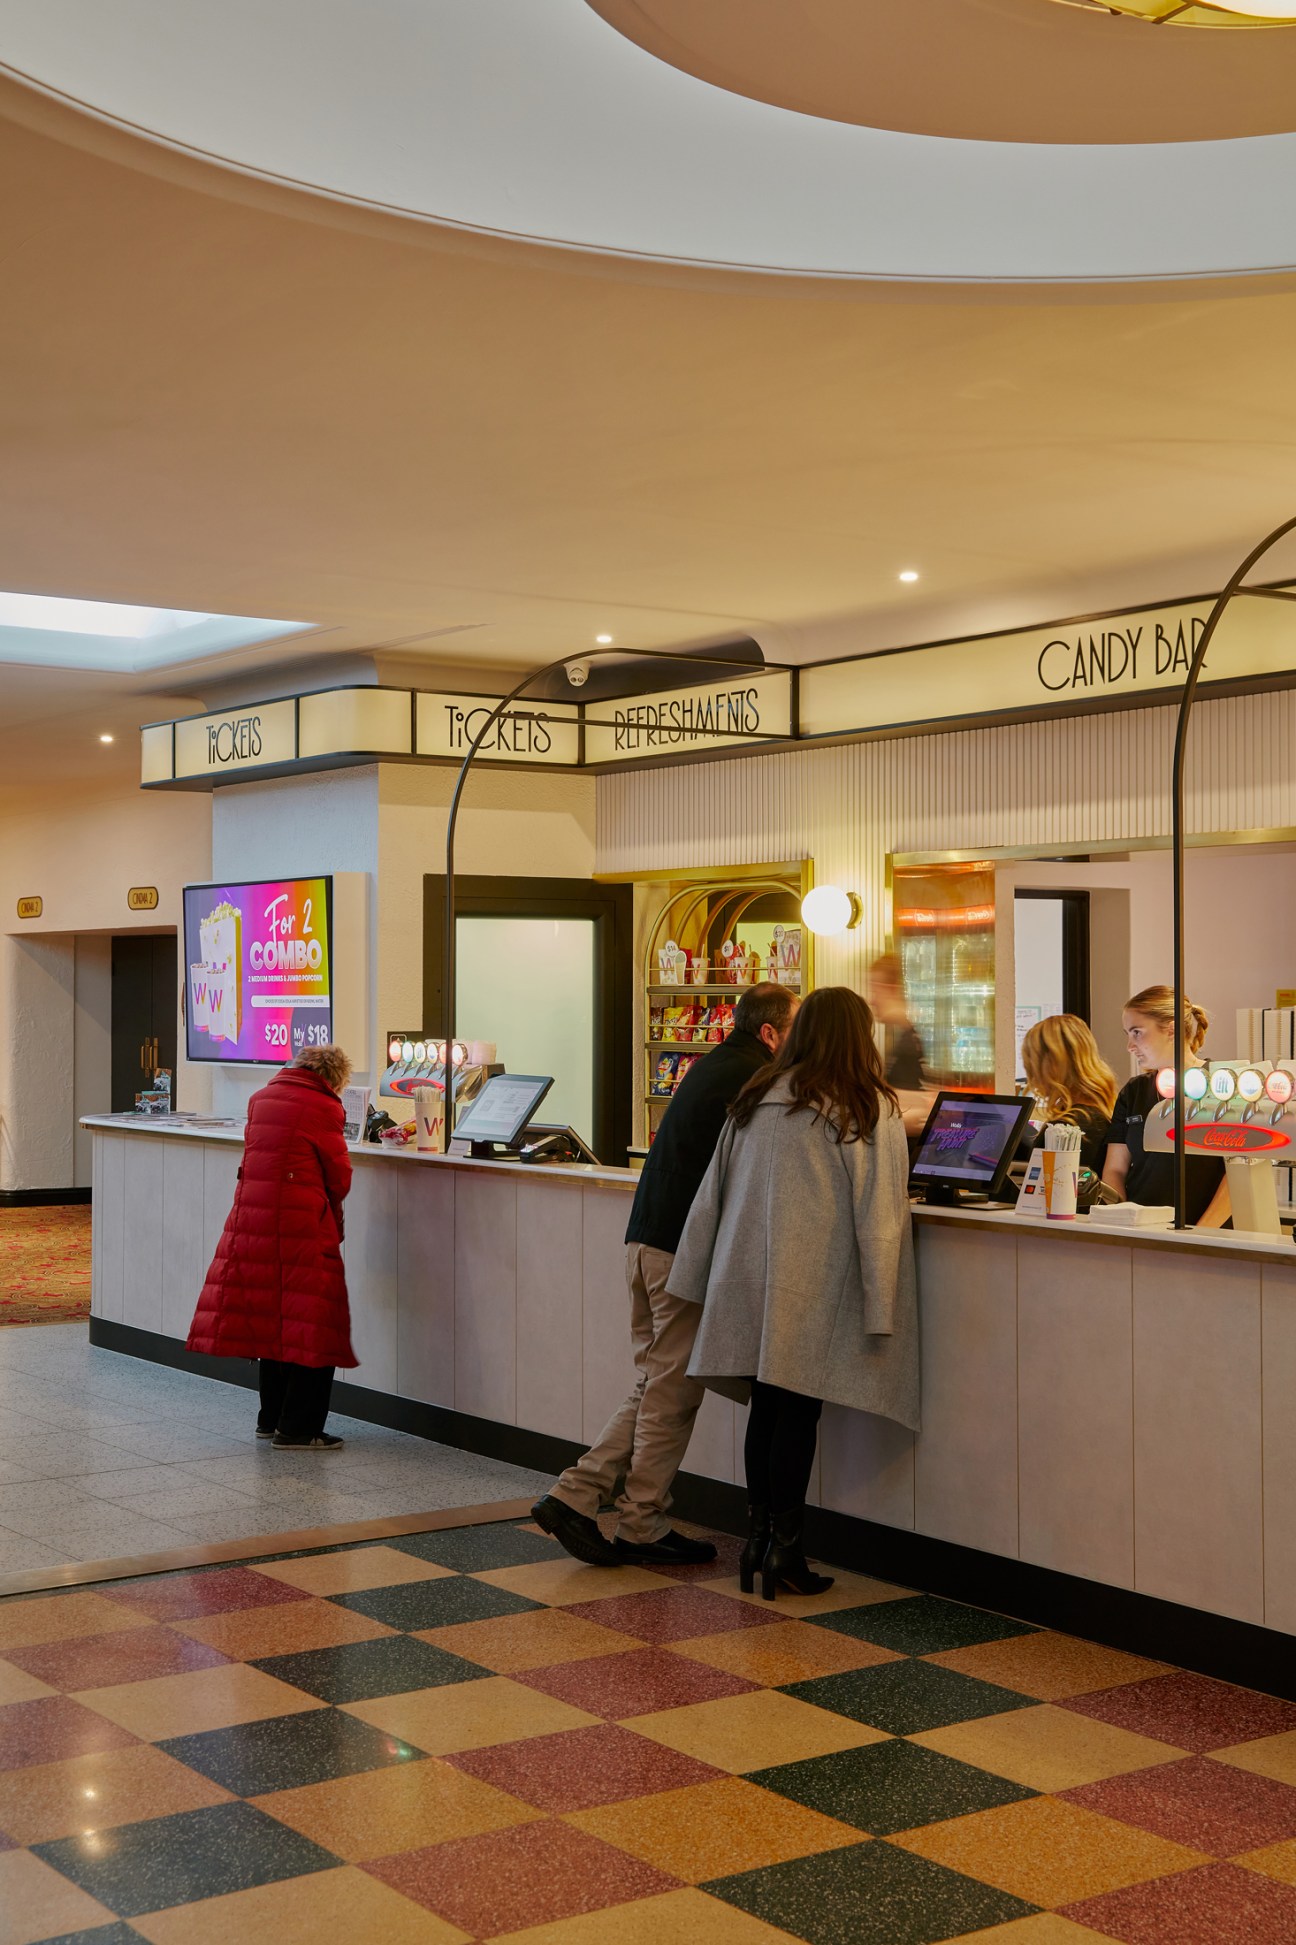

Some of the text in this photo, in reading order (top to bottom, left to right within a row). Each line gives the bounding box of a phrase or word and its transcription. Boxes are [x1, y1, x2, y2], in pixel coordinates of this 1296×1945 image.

[1038, 617, 1208, 690] CANDY BAR
[614, 688, 760, 751] REFRESHMENTS
[149, 892, 153, 904] 2
[264, 894, 313, 943] For 2
[250, 939, 322, 971] COMBO
[265, 1022, 288, 1046] $20
[294, 1027, 304, 1043] My
[308, 1023, 329, 1046] $18
[1216, 1077, 1229, 1094] Lift
[1204, 1127, 1249, 1148] Coca-Cola
